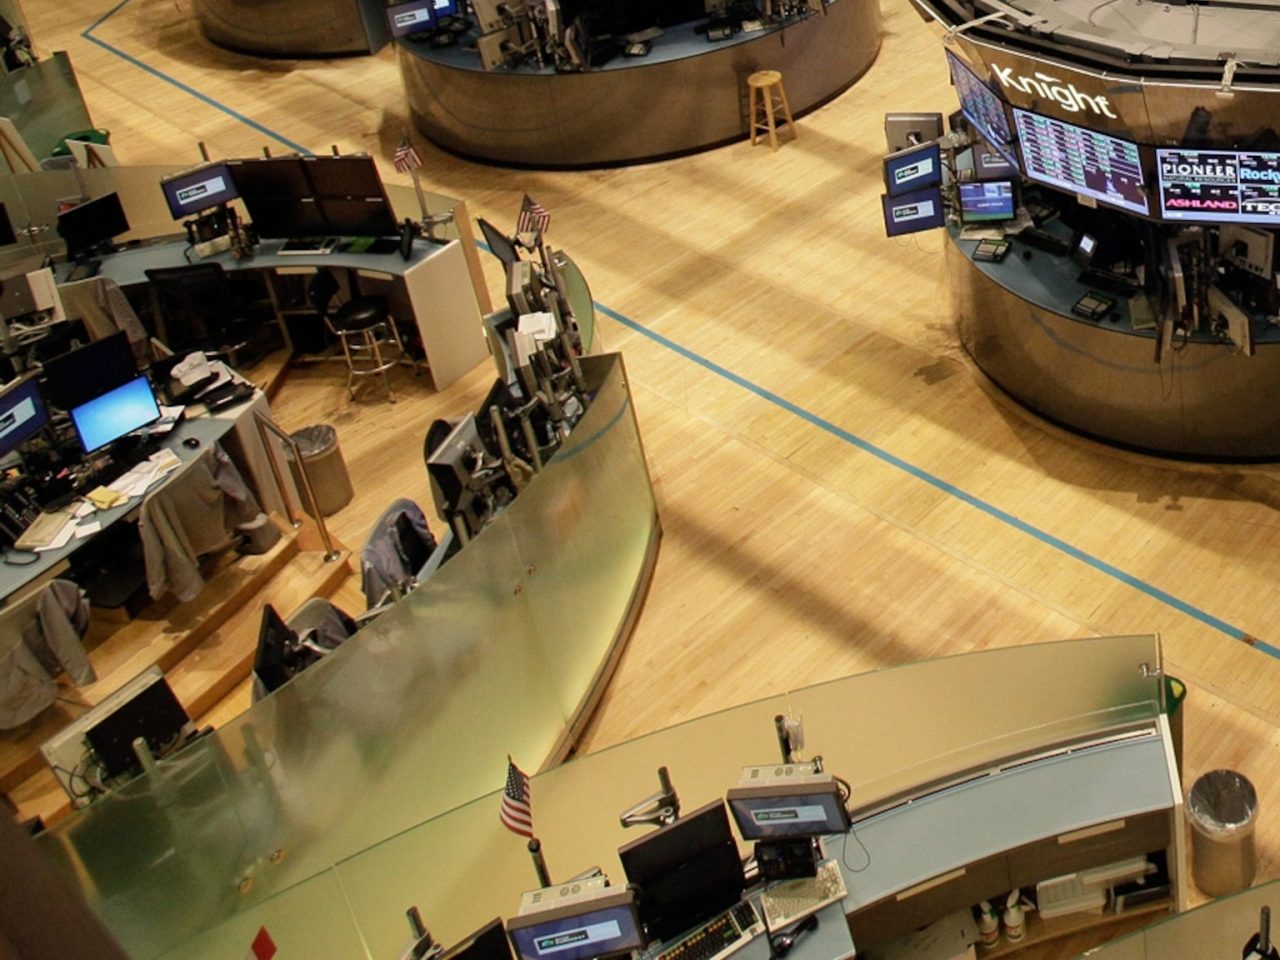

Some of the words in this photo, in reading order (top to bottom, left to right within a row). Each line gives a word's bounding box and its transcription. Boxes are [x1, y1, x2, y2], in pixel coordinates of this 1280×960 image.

[991, 63, 1118, 120] Knight
[1162, 163, 1236, 176] PIONEER
[1166, 198, 1237, 209] ASHLAND
